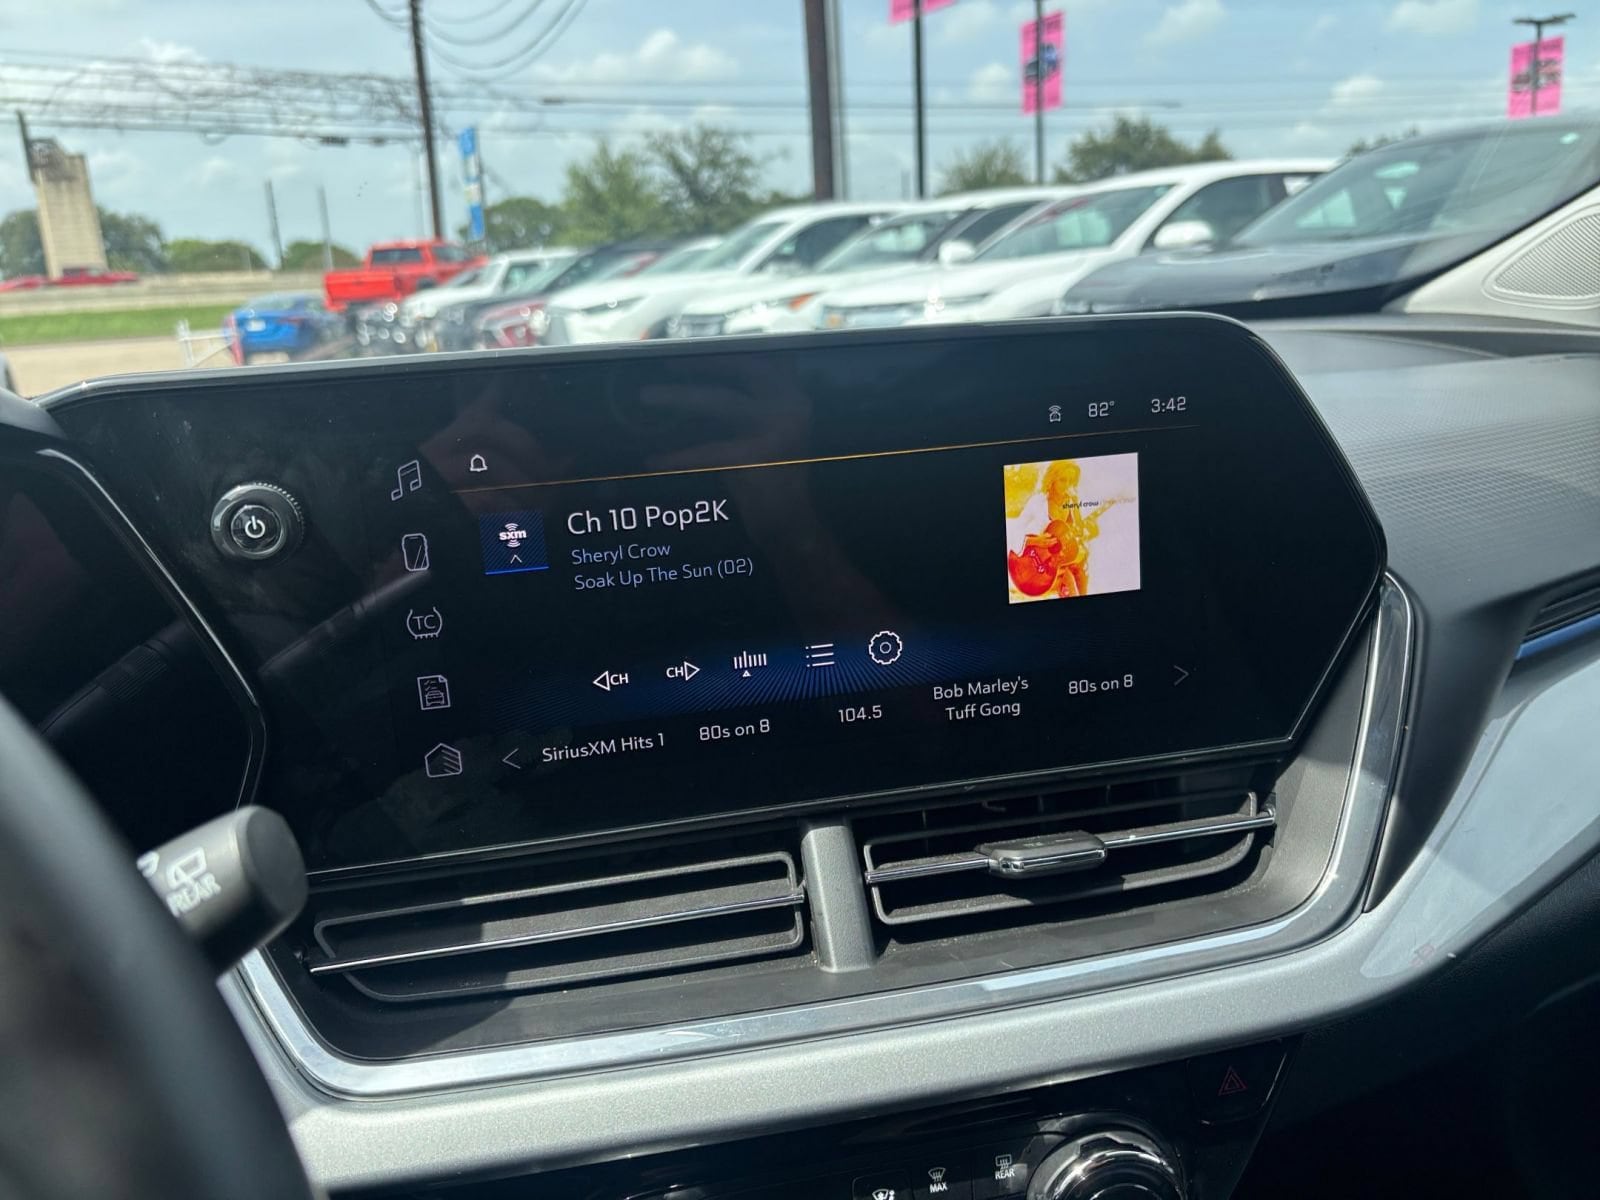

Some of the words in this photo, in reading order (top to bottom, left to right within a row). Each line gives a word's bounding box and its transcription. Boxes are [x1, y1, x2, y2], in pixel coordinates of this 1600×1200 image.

[1151, 396, 1187, 413] 3:42
[567, 510, 601, 535] Ch
[609, 507, 637, 531] 10
[645, 499, 729, 532] Pop2K
[499, 528, 527, 541] sxm
[571, 545, 623, 567] Sheryl
[628, 542, 671, 560] Crow
[574, 573, 616, 591] Soak
[620, 571, 643, 589] Up
[649, 566, 678, 582] The
[682, 563, 713, 580] Sun
[717, 557, 754, 580] (02)
[412, 614, 436, 631] TC
[610, 672, 629, 686] CH
[665, 666, 684, 680] CH
[933, 683, 963, 700] Bob
[968, 676, 1029, 698] Marley's
[1068, 679, 1097, 695] 80s
[1101, 678, 1120, 691] on
[1123, 674, 1134, 688] 8
[838, 705, 882, 723] 104.5
[946, 703, 976, 721] Tuff
[979, 701, 1021, 719] Gong
[699, 725, 731, 741] 80s
[735, 724, 755, 737] on
[760, 719, 771, 734] 8
[542, 739, 616, 763] SiriusXM
[621, 735, 654, 752] Hits
[658, 732, 665, 747] 1
[165, 872, 222, 917] REAR
[995, 1168, 1016, 1180] REAR
[929, 1182, 948, 1194] MAX
